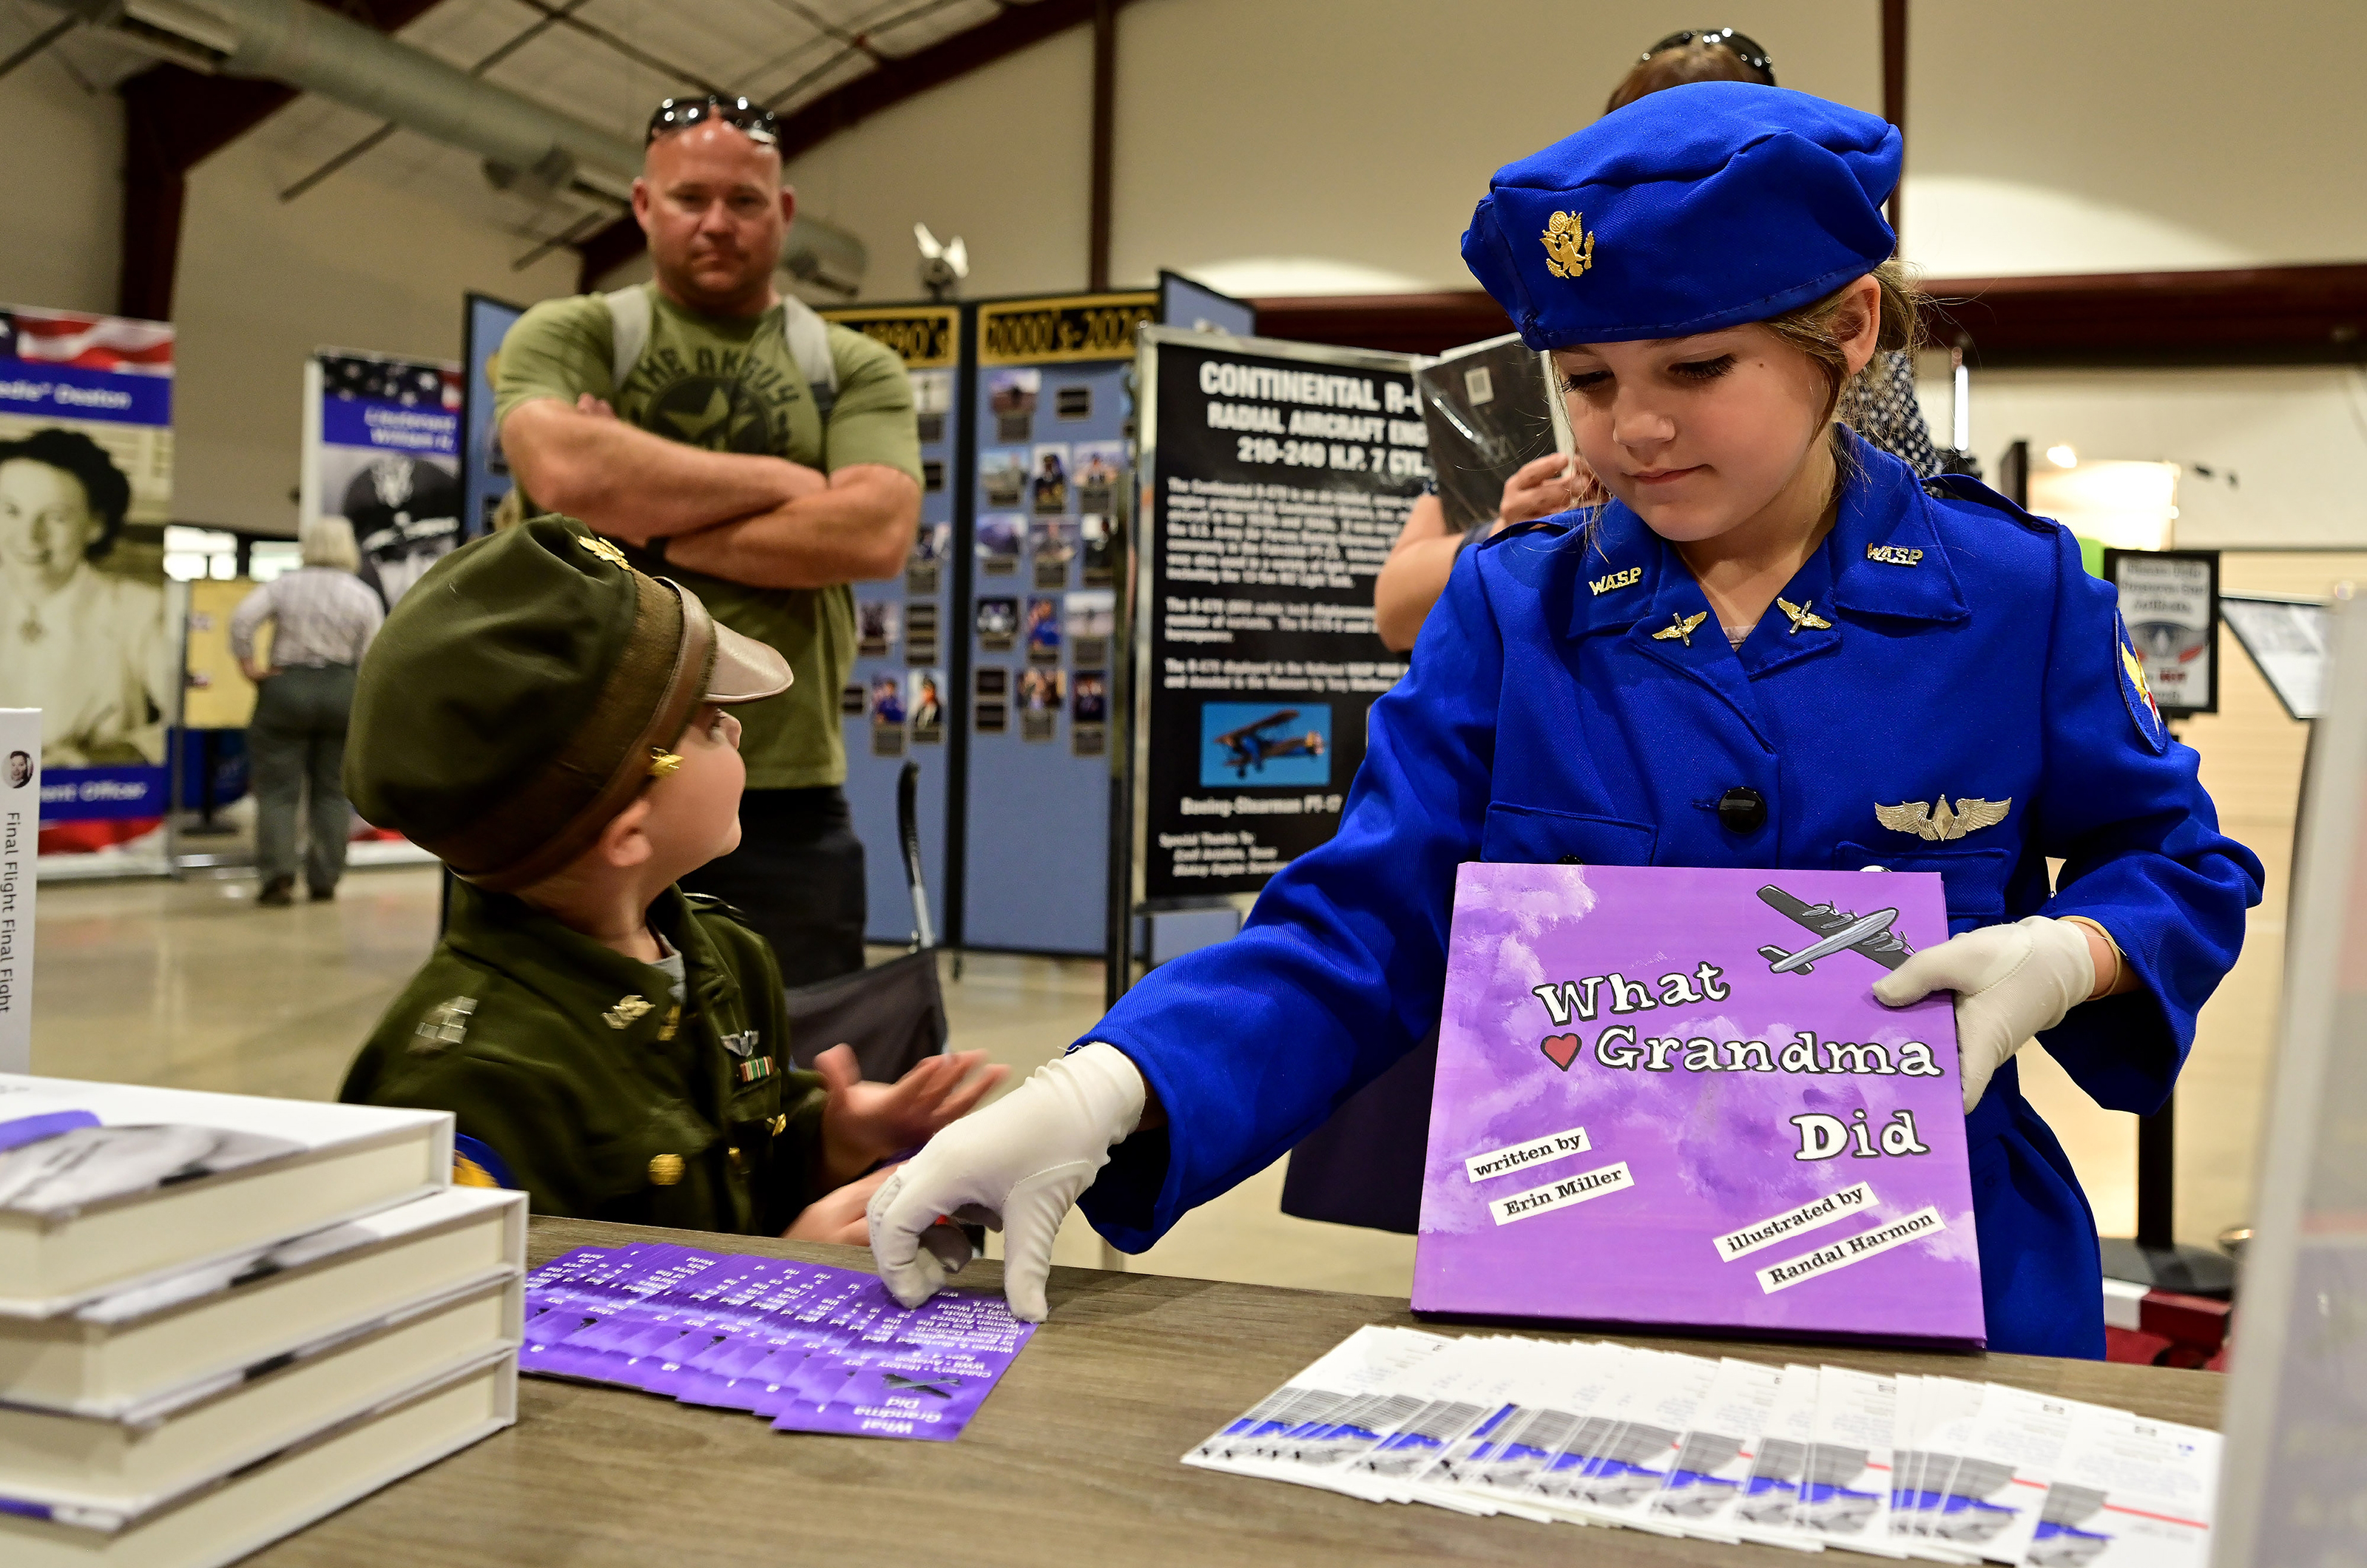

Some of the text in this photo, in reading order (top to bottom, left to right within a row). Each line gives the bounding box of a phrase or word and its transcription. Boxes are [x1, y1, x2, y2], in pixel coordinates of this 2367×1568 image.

[1199, 361, 1381, 412] CONTINENTAL
[1207, 402, 1286, 434] RADIAL
[1288, 410, 1386, 443] AIRCRAFT
[1237, 436, 1326, 468] 210-240
[1370, 448, 1385, 473] 7
[1867, 542, 1923, 567] WASP
[1588, 567, 1641, 595] WASP
[5, 812, 20, 854] Final
[0, 861, 18, 913] Flight
[1, 919, 16, 962] Final
[1534, 961, 1731, 1026] What
[1594, 1025, 1944, 1078] Grandma
[1789, 1109, 1931, 1162] Did
[1473, 1131, 1582, 1178] written by
[1503, 1166, 1623, 1217] Erin Miller
[1726, 1185, 1865, 1254] illustrated by
[1766, 1212, 1934, 1285] Randal Harmon
[929, 1314, 1019, 1329] Women Airforce
[936, 1302, 970, 1313] World
[942, 1310, 1017, 1323] Service Pilots
[914, 1325, 965, 1336] Danforth
[966, 1331, 1002, 1340] Elaine
[895, 1356, 944, 1366] Aviation
[971, 1344, 1013, 1354] Written
[877, 1361, 993, 1378] Children's History
[854, 1405, 942, 1423] Grandma
[885, 1396, 921, 1410] Did
[860, 1419, 913, 1433] What
